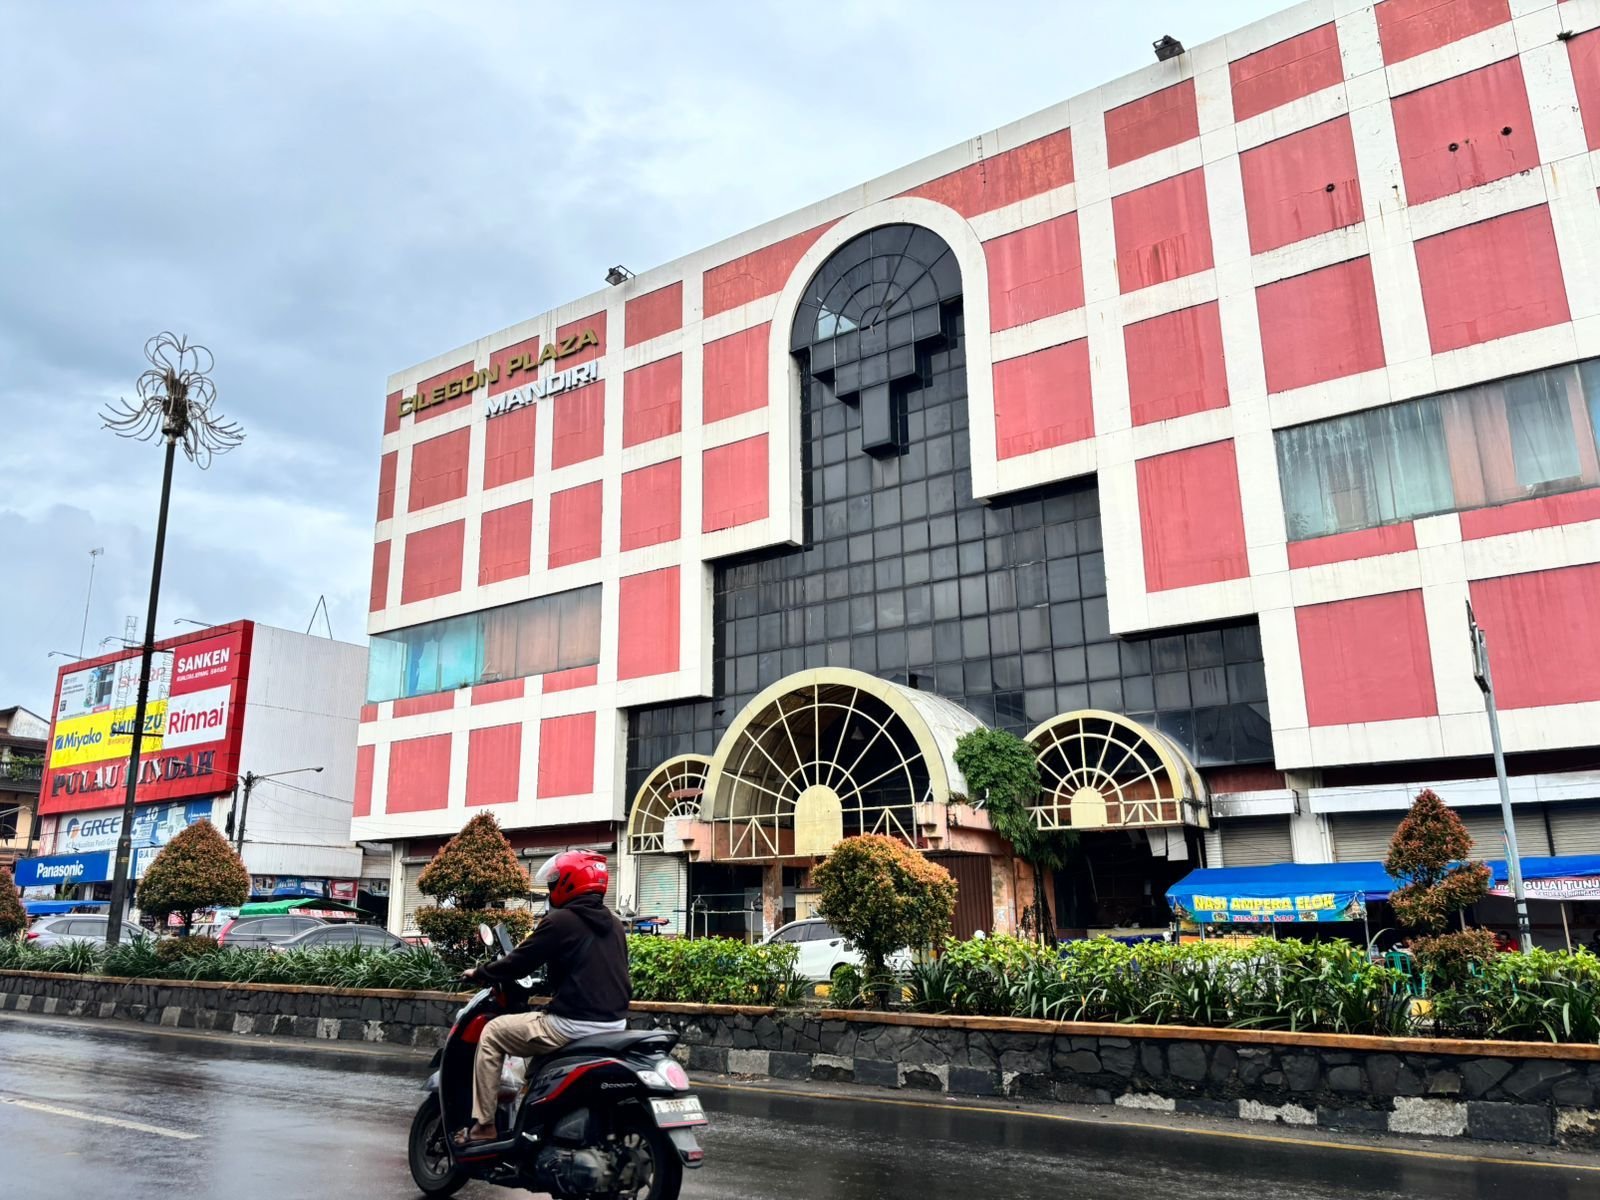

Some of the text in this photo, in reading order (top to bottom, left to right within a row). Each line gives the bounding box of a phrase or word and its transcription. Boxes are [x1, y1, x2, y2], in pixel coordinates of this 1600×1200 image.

[397, 328, 599, 417] CILEGON PLAZA
[485, 360, 599, 418] MANDIRI
[177, 646, 231, 673] SANKEN
[168, 701, 225, 735] Rinnai
[64, 727, 102, 752] Miyako
[52, 764, 121, 797] PULAU
[80, 816, 122, 837] GREE
[36, 860, 84, 878] Panasonic
[1523, 880, 1562, 891] GULAI
[1192, 893, 1337, 911] NASI AMPERA ELOK
